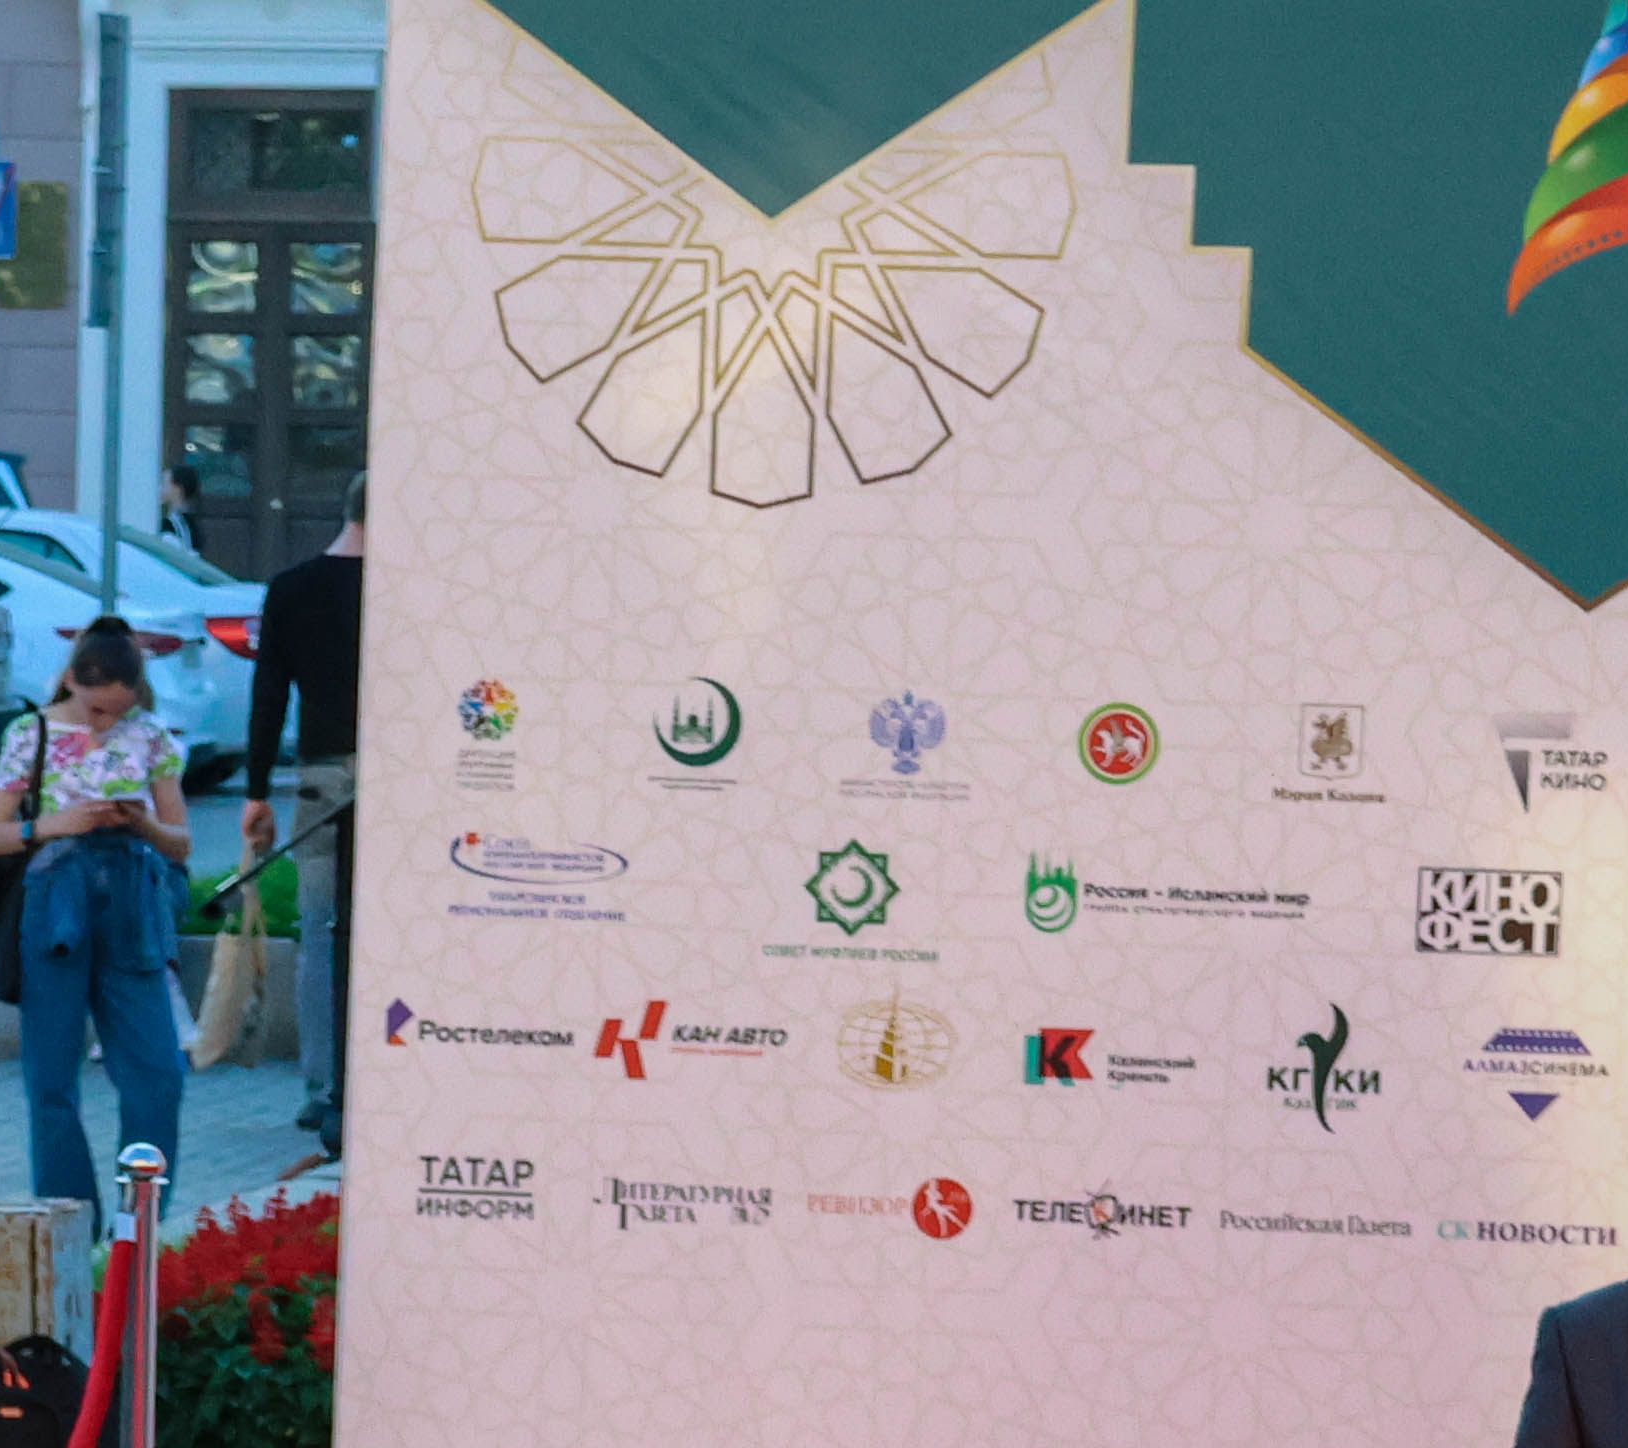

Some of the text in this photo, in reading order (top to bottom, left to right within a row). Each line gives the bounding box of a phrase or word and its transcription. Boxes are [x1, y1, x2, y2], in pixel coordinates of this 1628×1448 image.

[1541, 750, 1608, 768] ТАТАР
[1540, 772, 1608, 791] КИНО
[1422, 870, 1560, 914] КИНО
[1418, 914, 1559, 954] ФЕСТ
[418, 1020, 575, 1046] Ростелеком
[672, 1024, 789, 1046] КАН АВТО
[420, 1155, 534, 1187] ТАТАР
[415, 1198, 535, 1221] ИНФОРМ
[1218, 1208, 1343, 1235] Российская
[1476, 1221, 1617, 1247] НОВОСТИ
